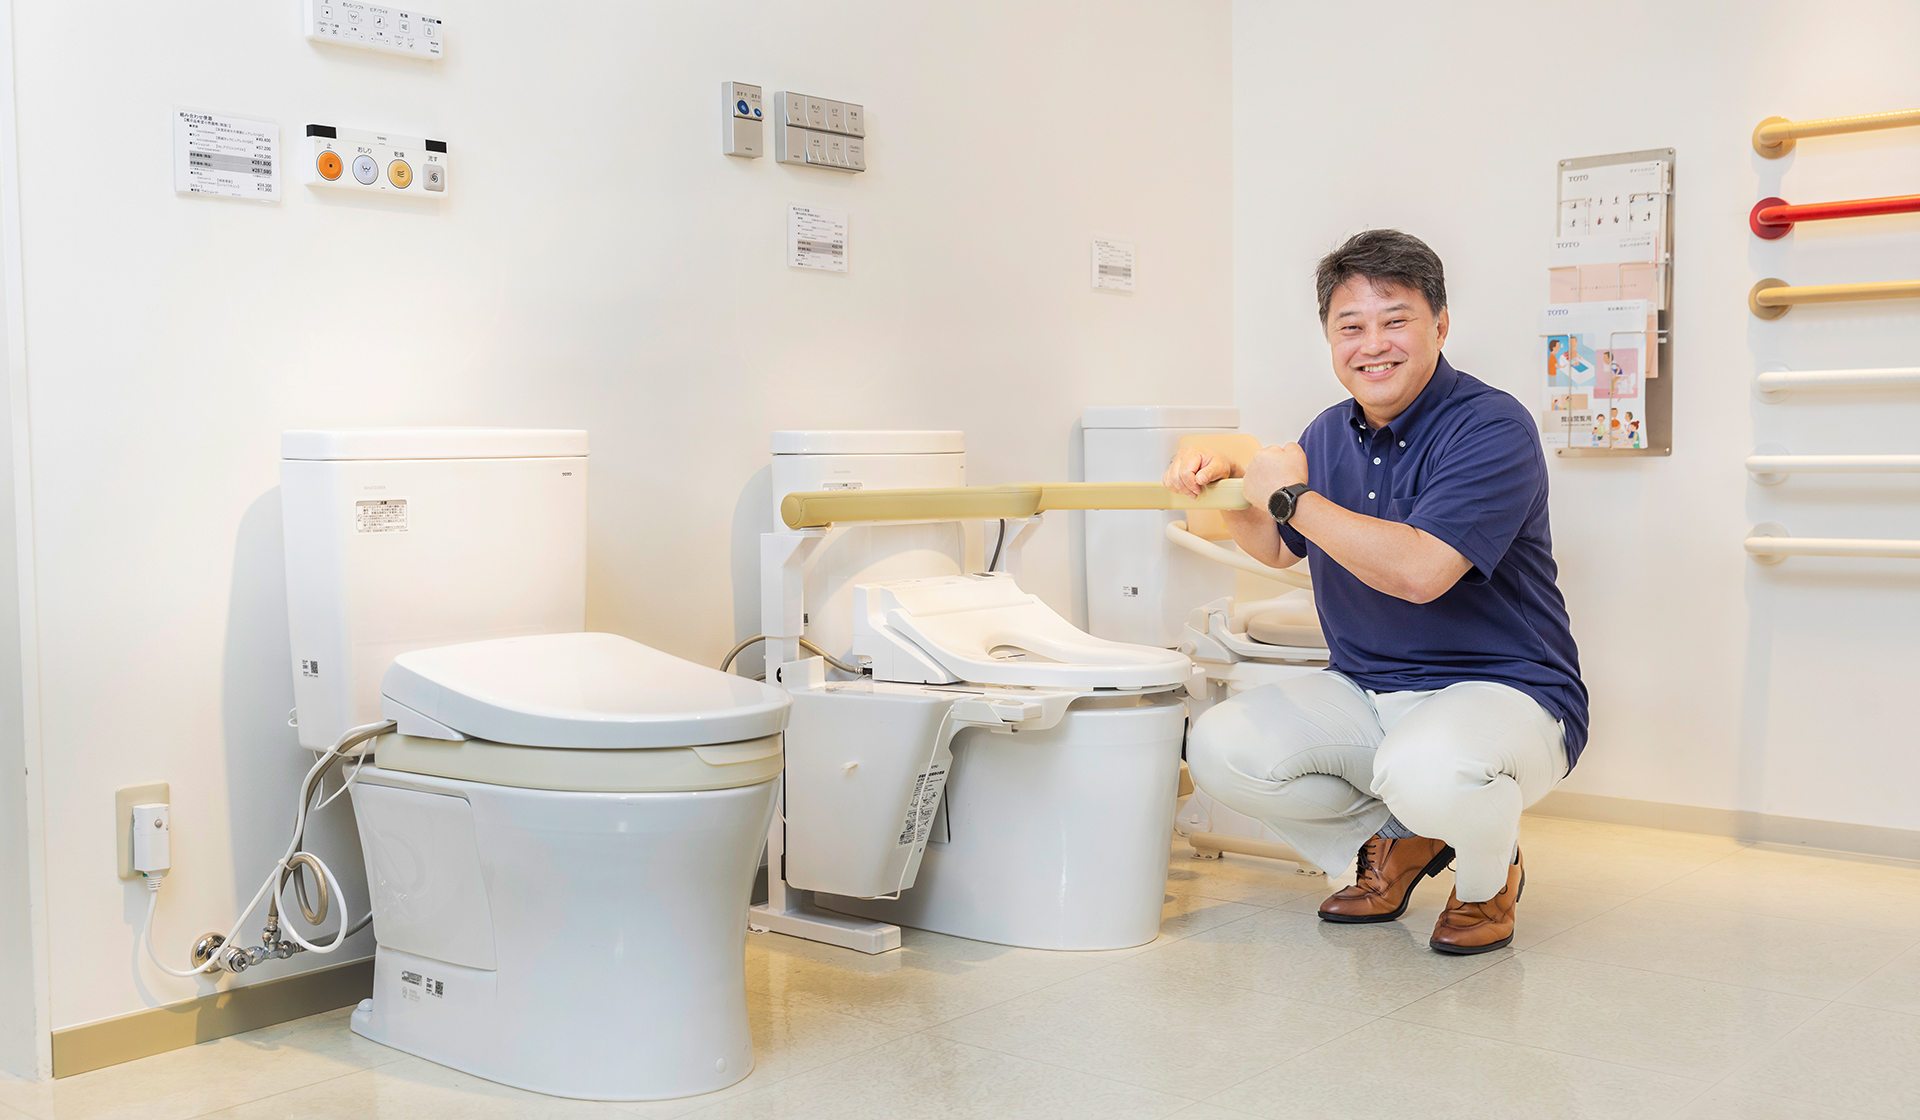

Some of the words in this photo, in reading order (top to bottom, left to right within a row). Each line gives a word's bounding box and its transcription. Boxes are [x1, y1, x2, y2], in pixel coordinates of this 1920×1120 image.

[357, 146, 372, 154] おしり
[1568, 174, 1589, 183] TOTO
[1555, 241, 1580, 249] TOTO
